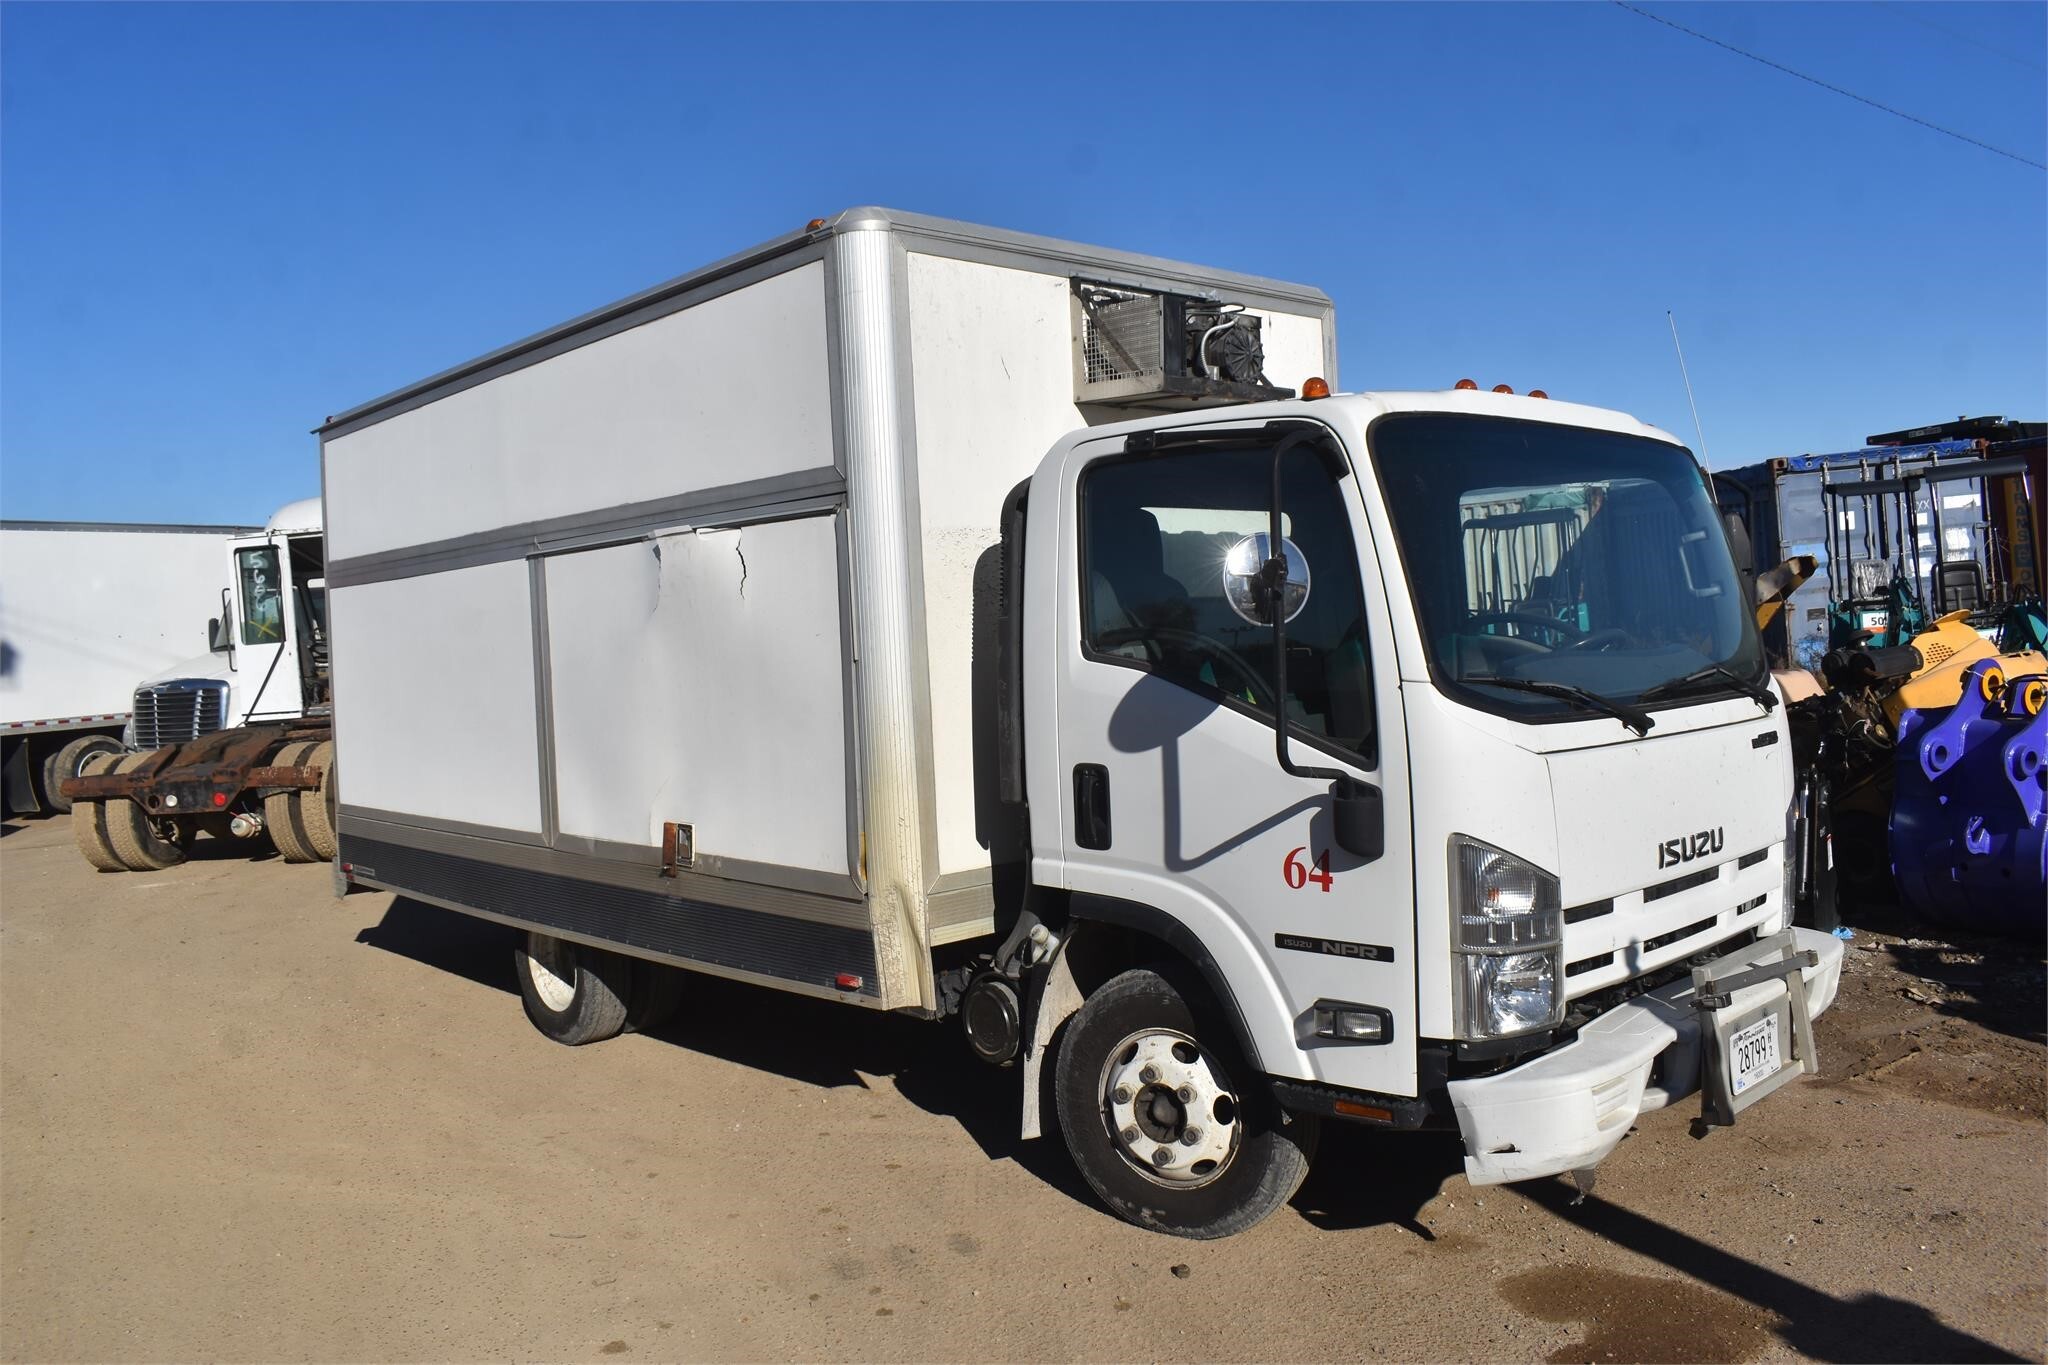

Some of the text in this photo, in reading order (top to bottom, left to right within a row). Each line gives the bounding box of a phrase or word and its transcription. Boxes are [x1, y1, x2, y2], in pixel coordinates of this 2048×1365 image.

[1658, 826, 1724, 870] ISUZU
[1283, 846, 1334, 892] 64
[1283, 938, 1379, 960] ISUZU NPR
[1738, 1035, 1766, 1074] 28799
